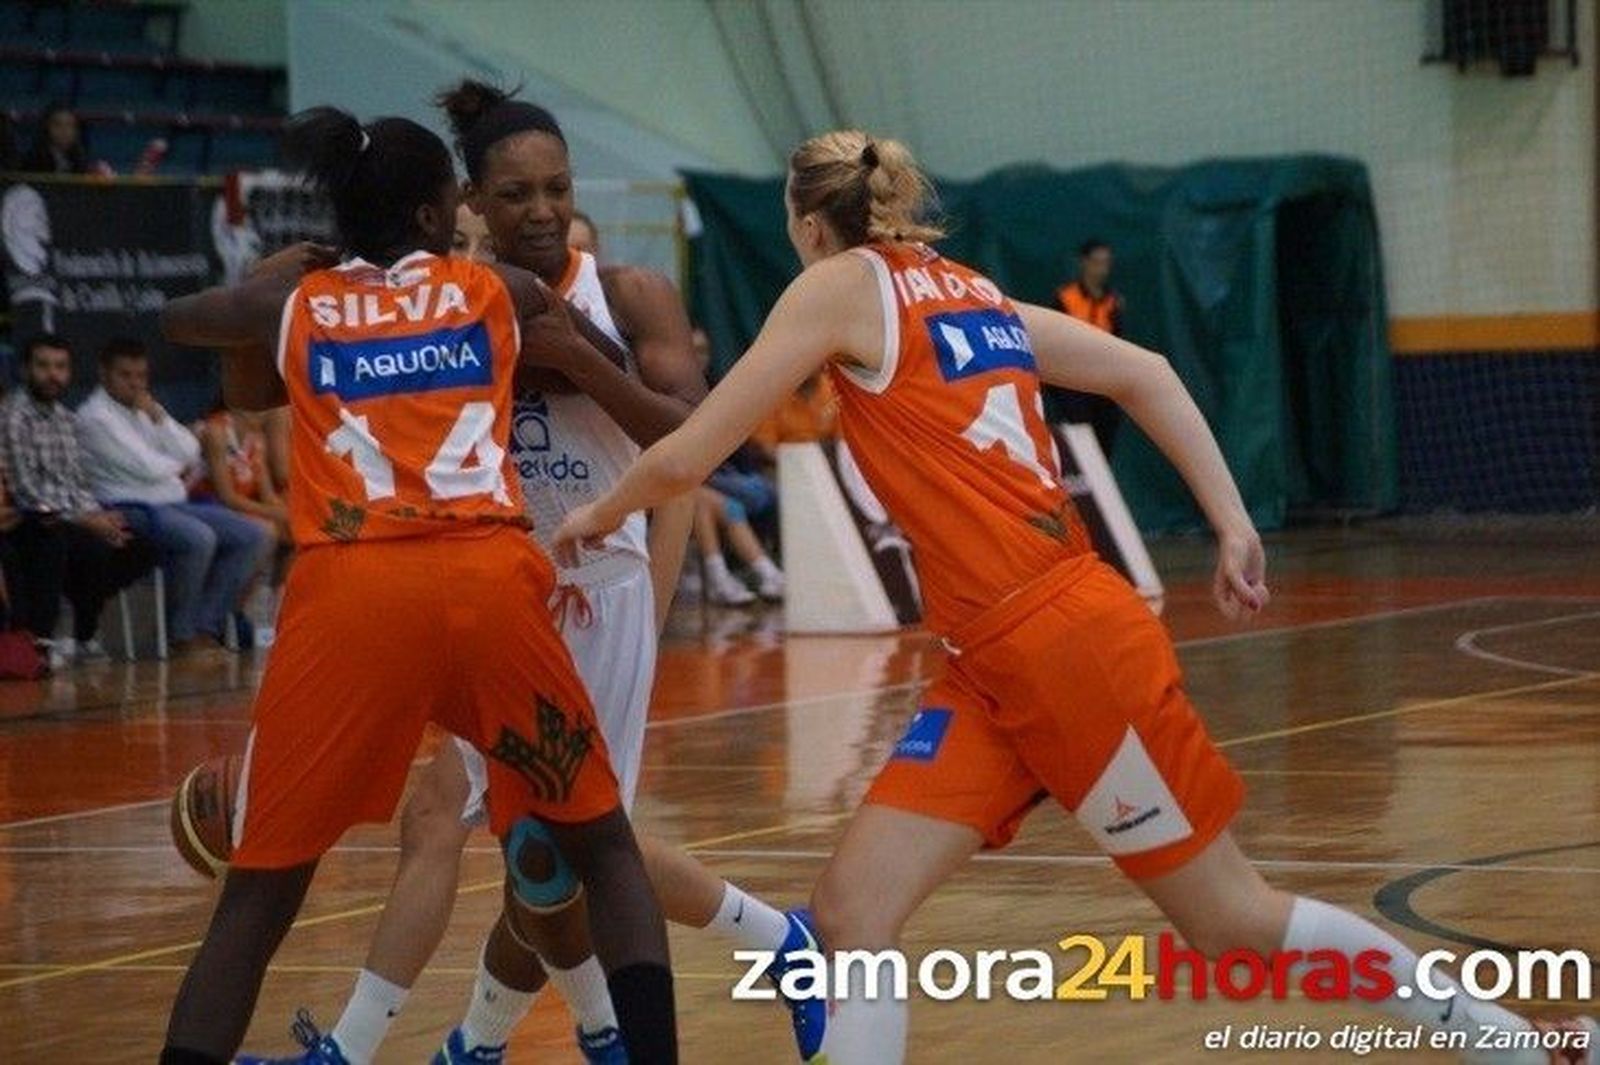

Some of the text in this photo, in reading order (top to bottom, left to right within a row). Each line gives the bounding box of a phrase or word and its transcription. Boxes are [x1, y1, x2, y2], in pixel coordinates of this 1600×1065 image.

[309, 282, 469, 328] SILVA
[354, 341, 481, 382] AQUONA
[325, 402, 514, 507] 14
[959, 383, 1061, 489] 1
